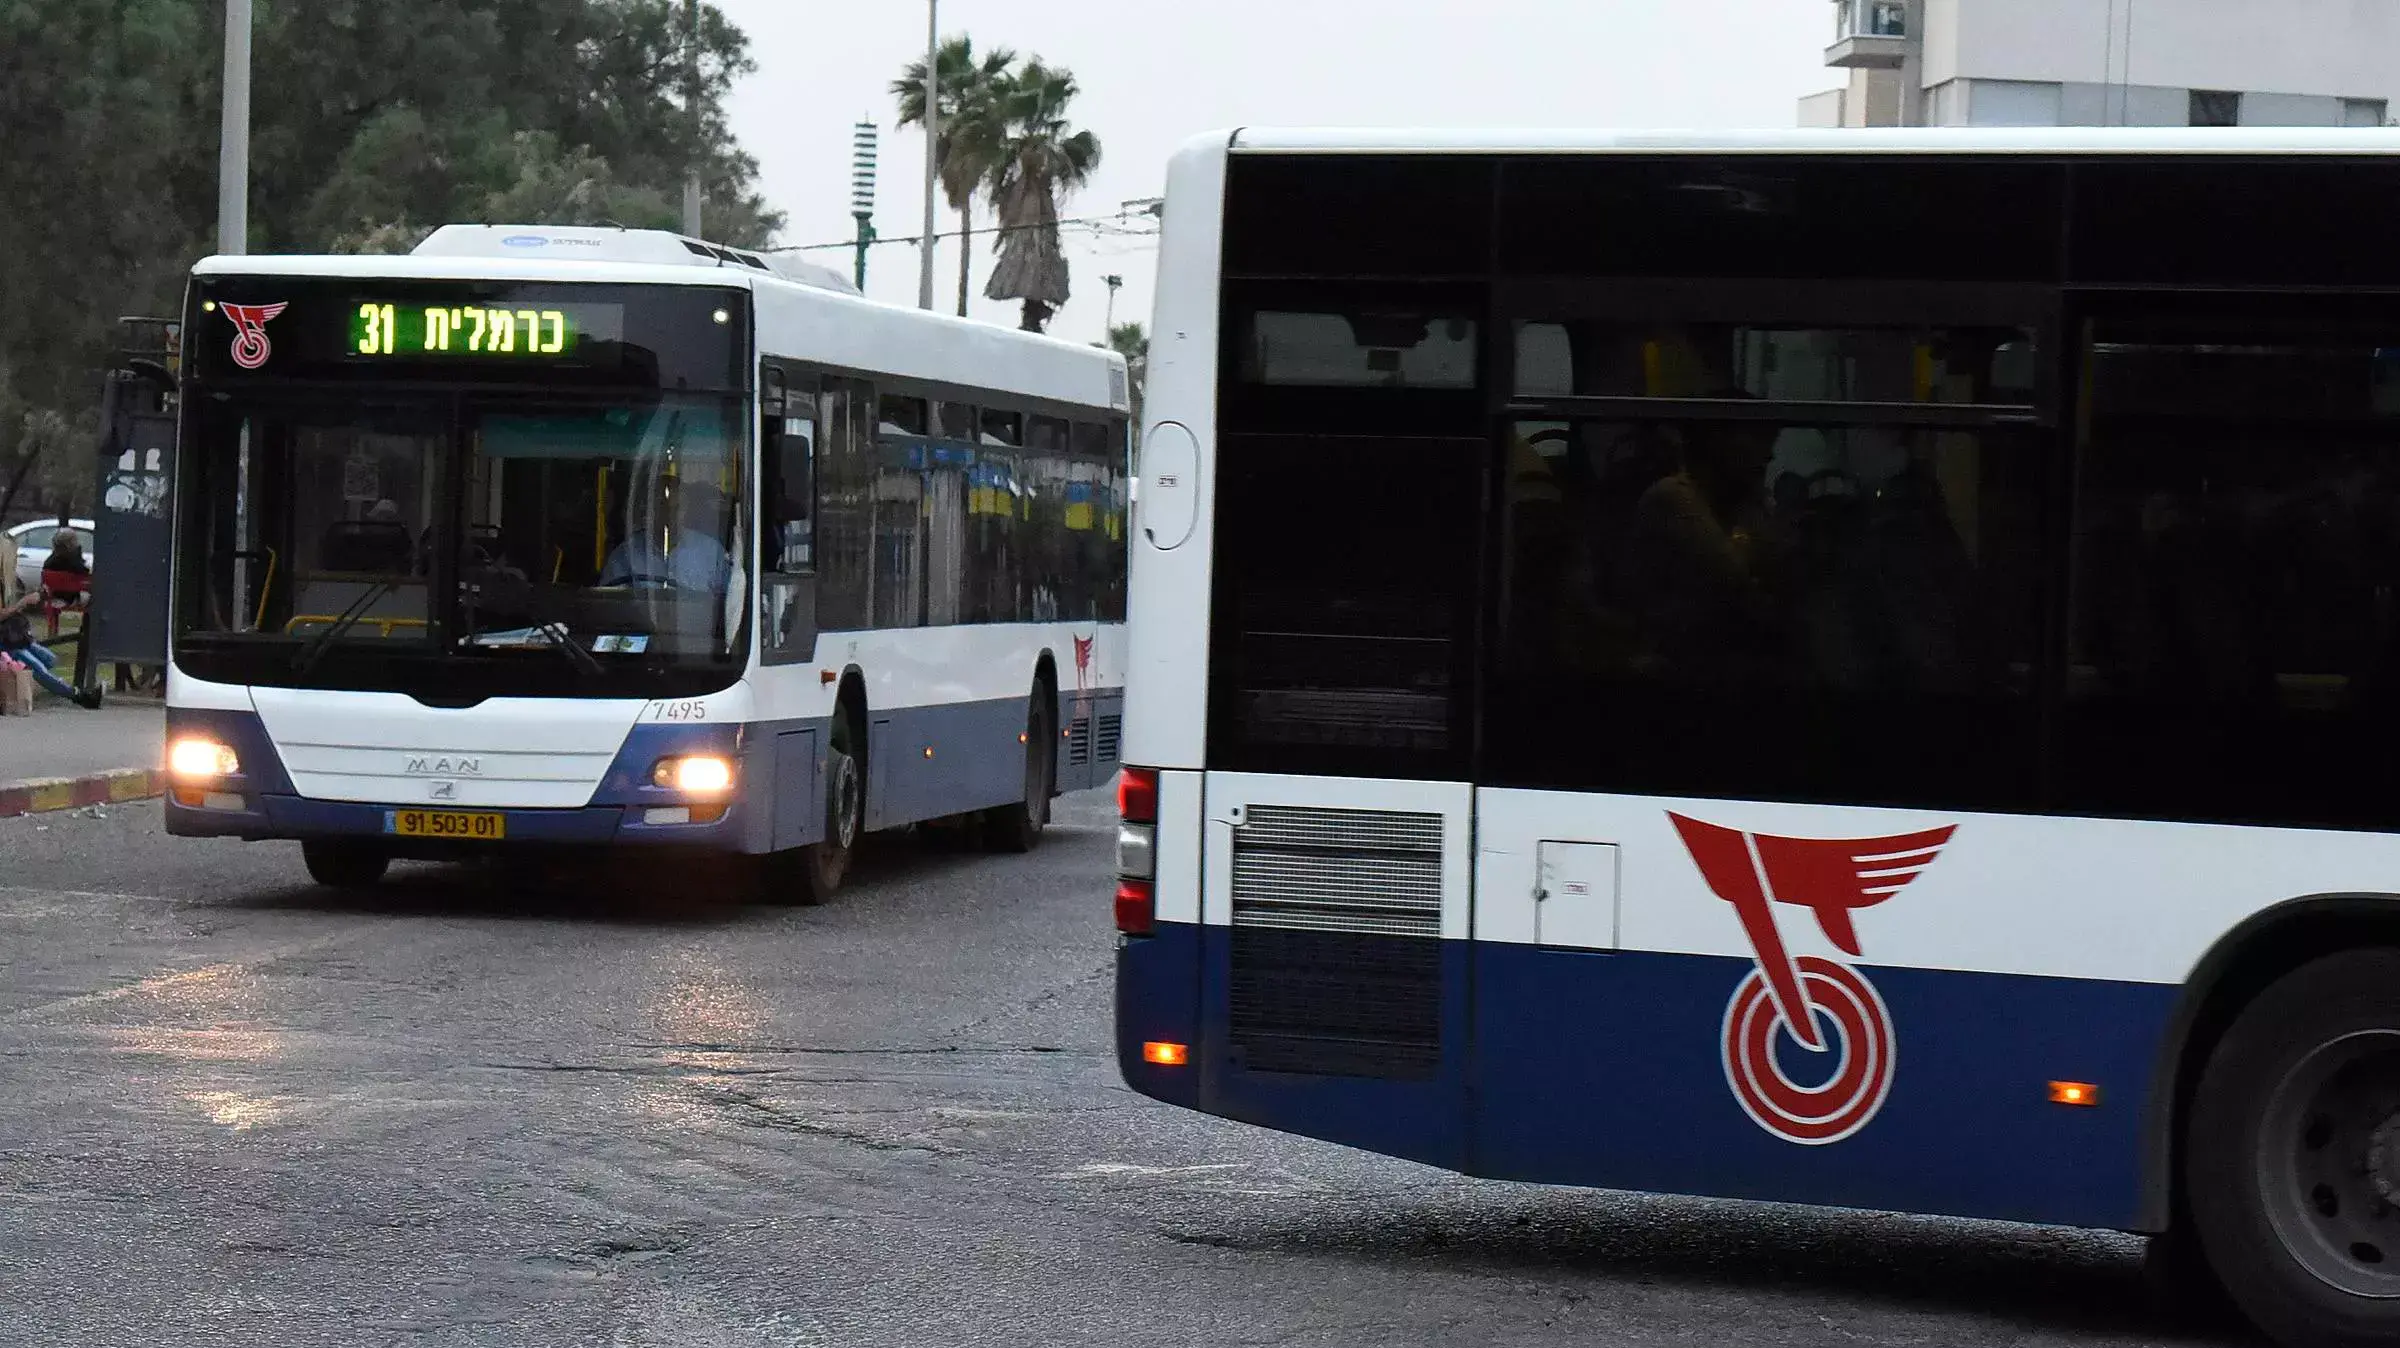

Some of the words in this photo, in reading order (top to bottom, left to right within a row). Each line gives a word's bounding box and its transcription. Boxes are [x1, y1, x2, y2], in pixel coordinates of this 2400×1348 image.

[358, 303, 395, 354] 31
[424, 306, 564, 353] כרמלית
[653, 701, 706, 720] 7495
[406, 758, 480, 772] MAN
